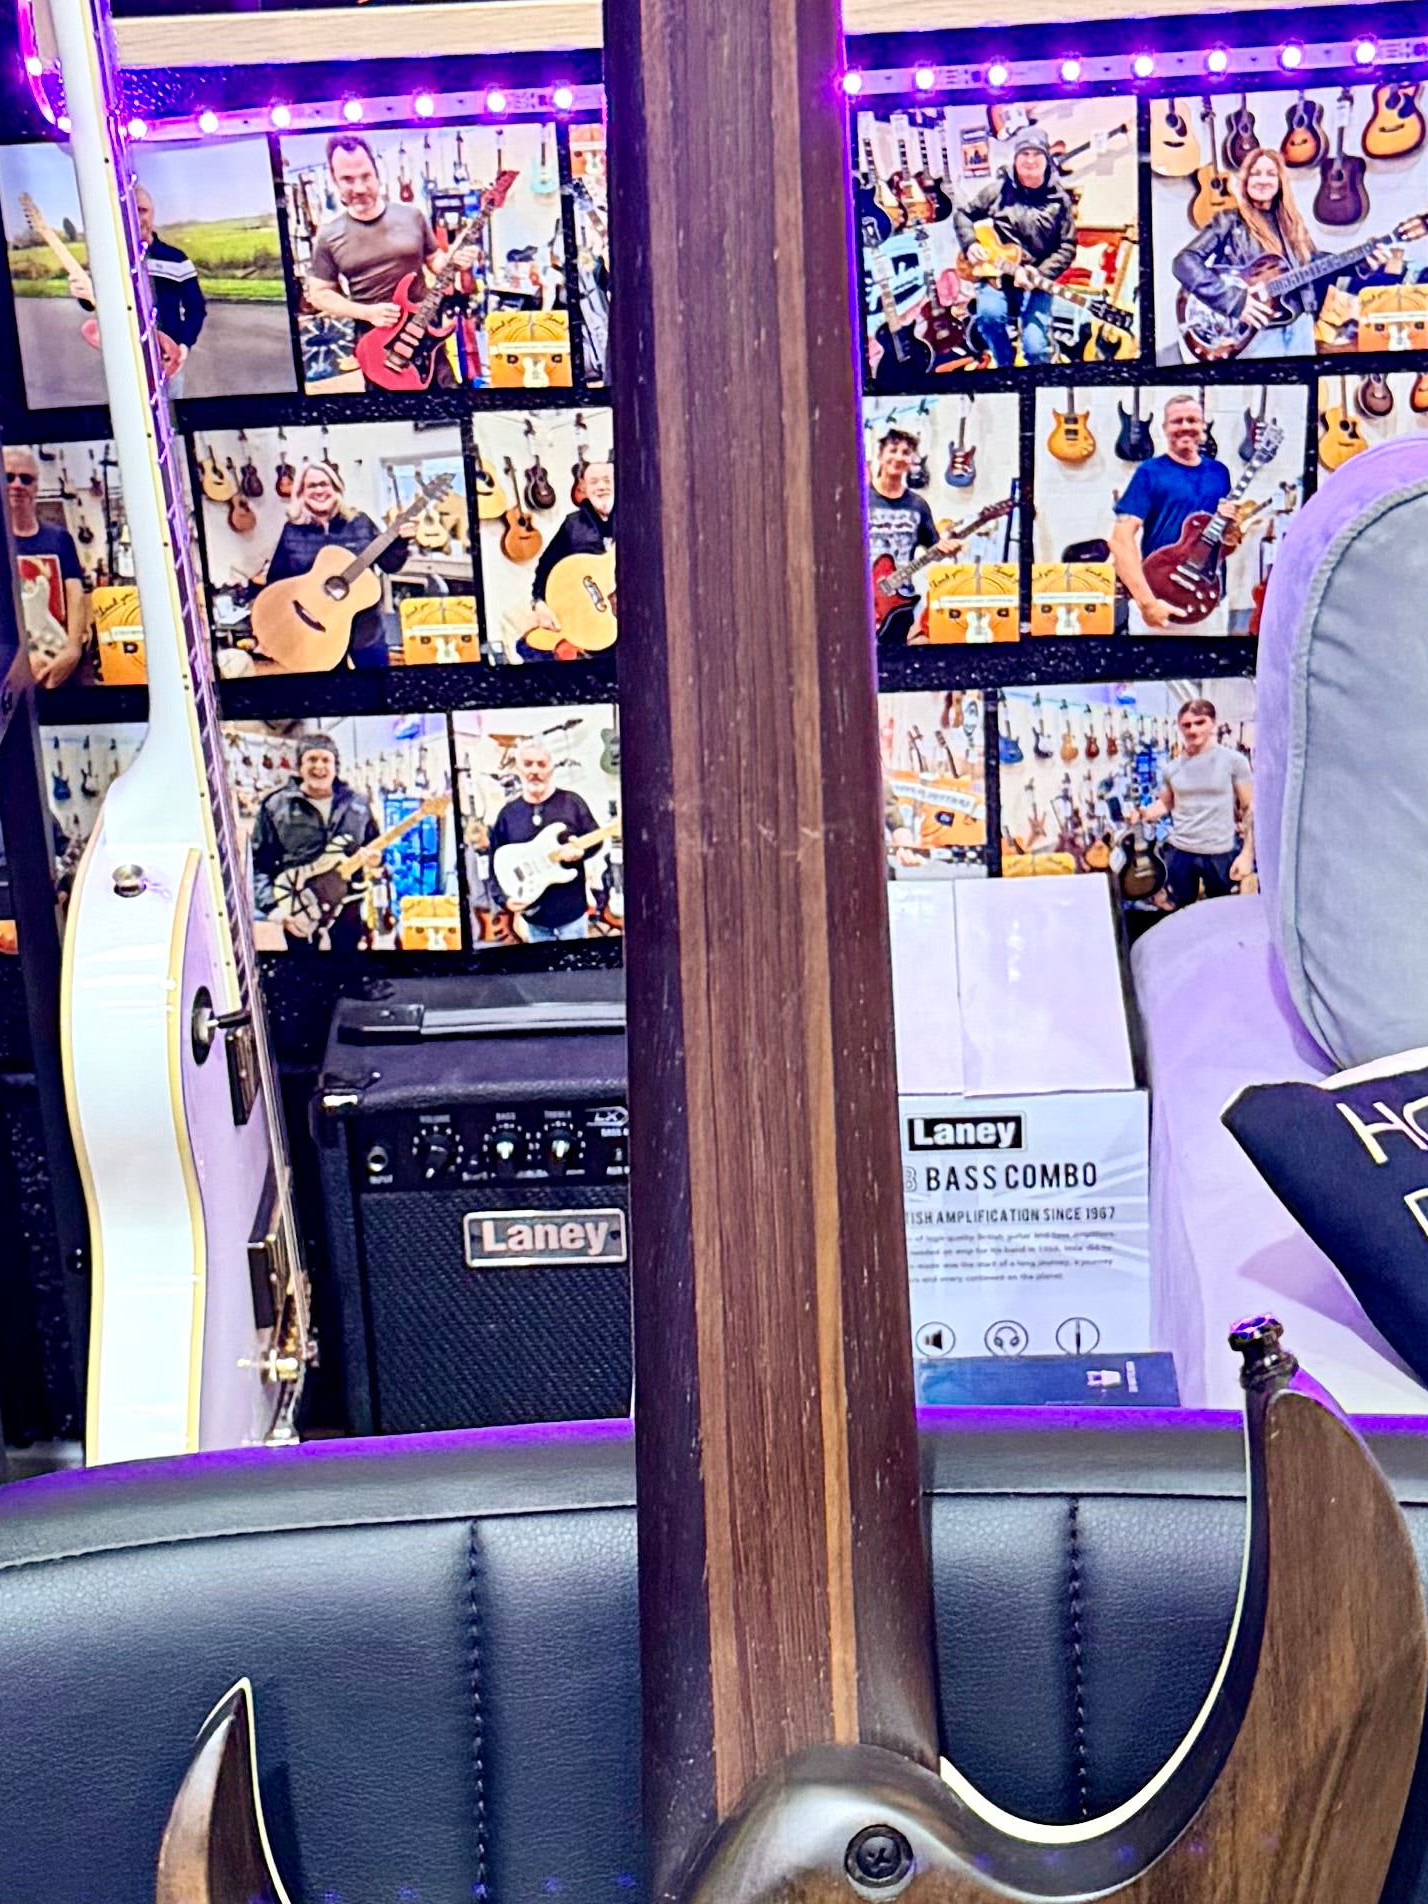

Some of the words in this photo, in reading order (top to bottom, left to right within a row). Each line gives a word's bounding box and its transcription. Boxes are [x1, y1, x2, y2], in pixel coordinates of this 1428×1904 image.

[912, 1117, 1017, 1149] Laney
[925, 1164, 998, 1192] BASS
[1004, 1161, 1098, 1191] COMBO
[936, 1207, 1040, 1225] AMPLIFICATION
[1043, 1207, 1081, 1222] SINCE
[481, 1219, 611, 1256] Laney
